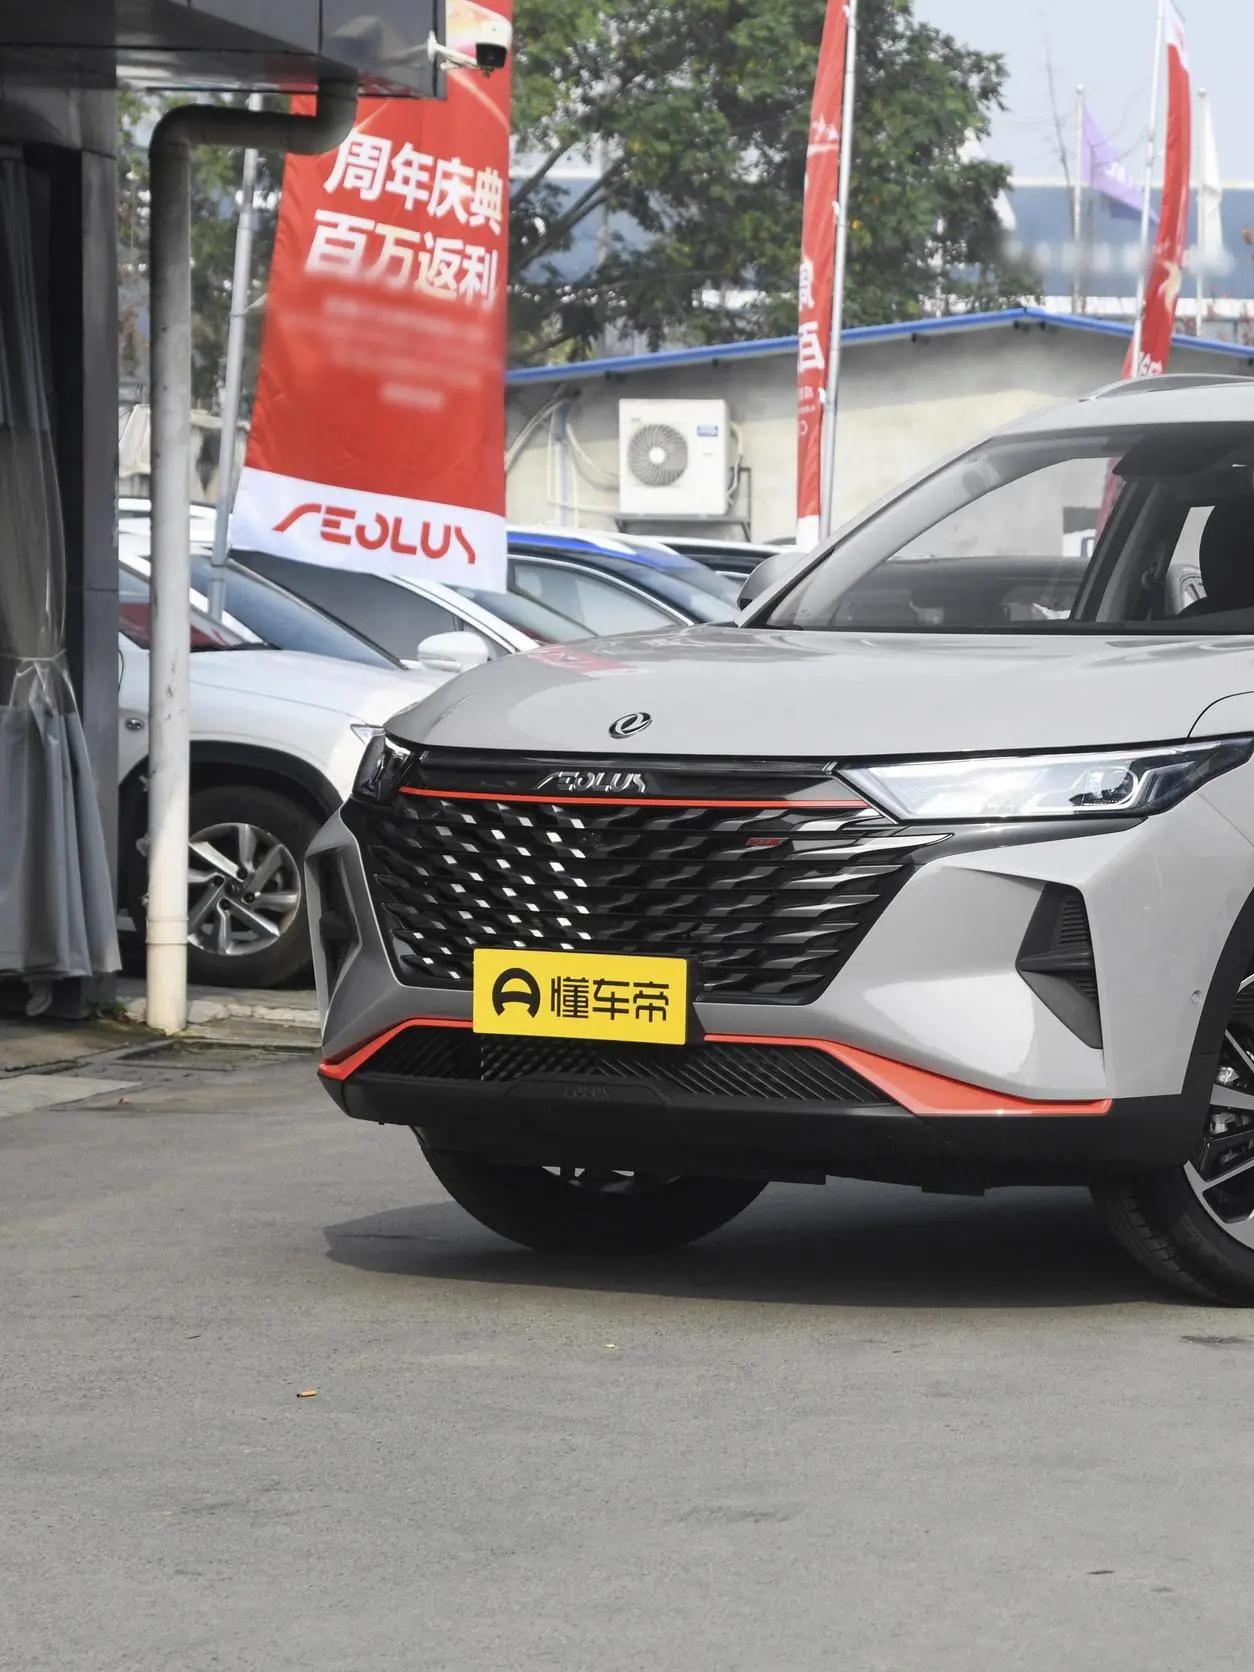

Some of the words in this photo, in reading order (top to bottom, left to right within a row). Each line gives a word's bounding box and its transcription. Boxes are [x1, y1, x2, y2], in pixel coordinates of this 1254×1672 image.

[324, 130, 503, 236] 周年庆典
[305, 208, 498, 312] 百万返利
[550, 975, 669, 1023] 懂车帝
